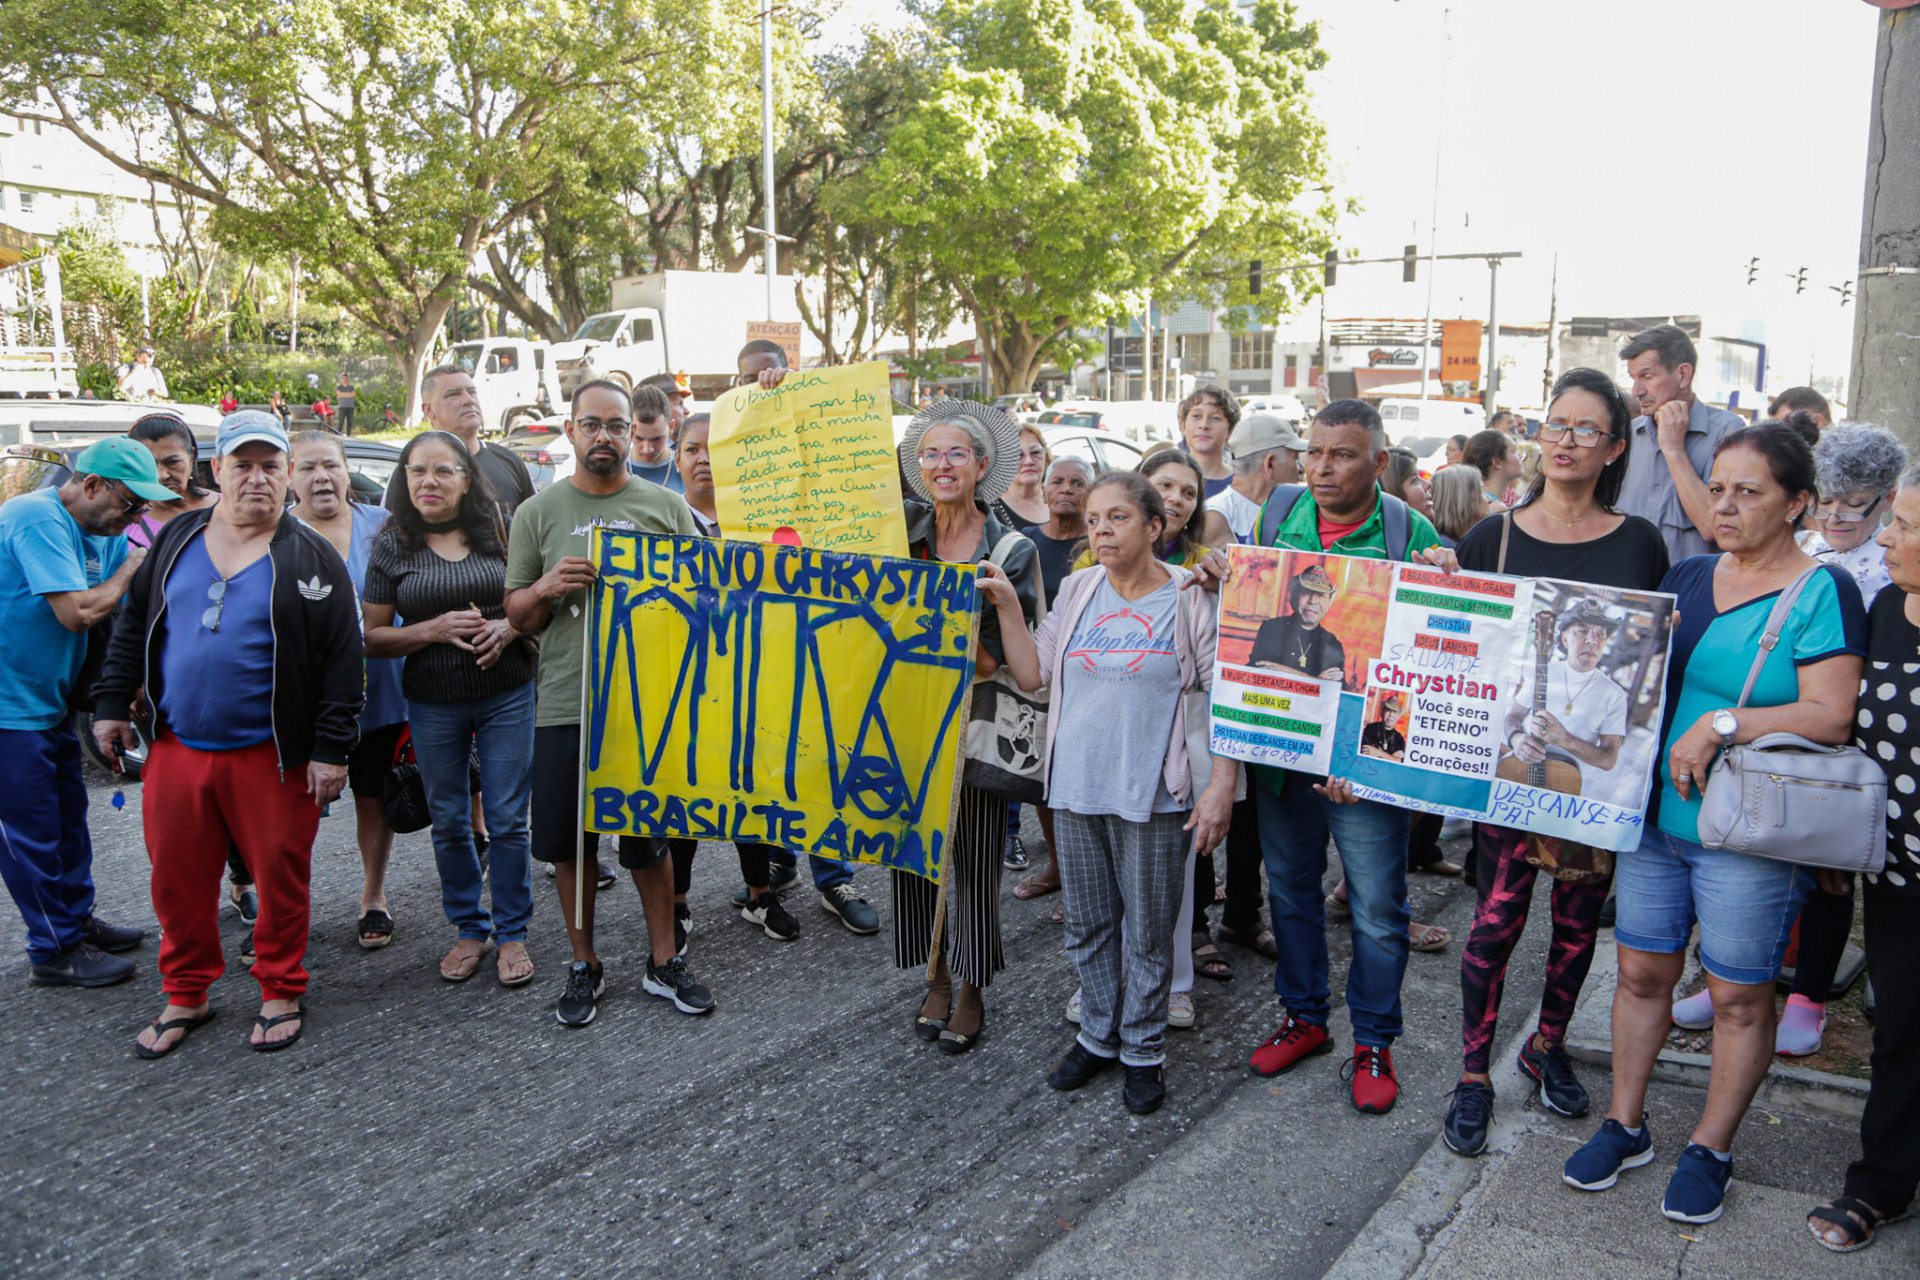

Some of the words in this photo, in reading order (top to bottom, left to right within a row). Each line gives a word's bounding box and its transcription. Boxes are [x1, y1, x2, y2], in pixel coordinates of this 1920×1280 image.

[749, 322, 800, 336] ATENÇÃO
[1447, 356, 1459, 365] 24
[794, 418, 822, 434] da
[827, 412, 882, 427] minha
[799, 440, 824, 450] na
[799, 471, 822, 479] na
[828, 461, 876, 475] minha
[848, 448, 893, 471] para
[810, 488, 838, 502] que
[776, 515, 818, 525] nome
[823, 512, 843, 522] de
[600, 530, 764, 592] ETERNO
[1407, 570, 1433, 583] BRASIL
[1435, 575, 1462, 587] CHORA
[1464, 579, 1481, 590] UMA
[1483, 582, 1516, 596] GRANDE
[1396, 590, 1420, 603] PERCA
[1421, 593, 1432, 605] DO
[1433, 596, 1466, 610] CANTOR
[1468, 601, 1513, 618] SERTANEJO
[1427, 616, 1471, 633] CHRYSTIAN
[1441, 638, 1479, 656] LAMENTO
[1227, 670, 1251, 683] MUSICA
[1253, 675, 1293, 690] SERTANEJA
[1295, 683, 1320, 695] CHORA
[1375, 663, 1497, 701] Chrystian
[1242, 692, 1260, 704] MAIS
[1260, 696, 1275, 707] UMA
[1277, 699, 1291, 710] VEZ
[1417, 698, 1453, 715] Você
[1457, 706, 1489, 721] sera
[1217, 707, 1237, 719] PERCA
[1238, 711, 1247, 721] DE
[1249, 713, 1260, 724] UM
[1261, 716, 1290, 730] GRANDE
[1292, 722, 1322, 735] CANTOR
[1415, 715, 1488, 738] "ETERNO"
[1214, 724, 1248, 740] CHRYSTIAN
[1248, 733, 1286, 749] DESCANSE
[1288, 740, 1298, 750] EM
[1299, 742, 1315, 754] PAZ
[1412, 735, 1434, 748] em
[1439, 740, 1492, 758] nossos
[1251, 745, 1302, 765] CHORA
[1409, 750, 1489, 775] Corações!!
[1352, 786, 1397, 803] NTINHO
[1402, 796, 1421, 809] NO
[1494, 781, 1612, 826] DESCANSE
[591, 786, 758, 841] BRASIL
[752, 800, 807, 845] TE
